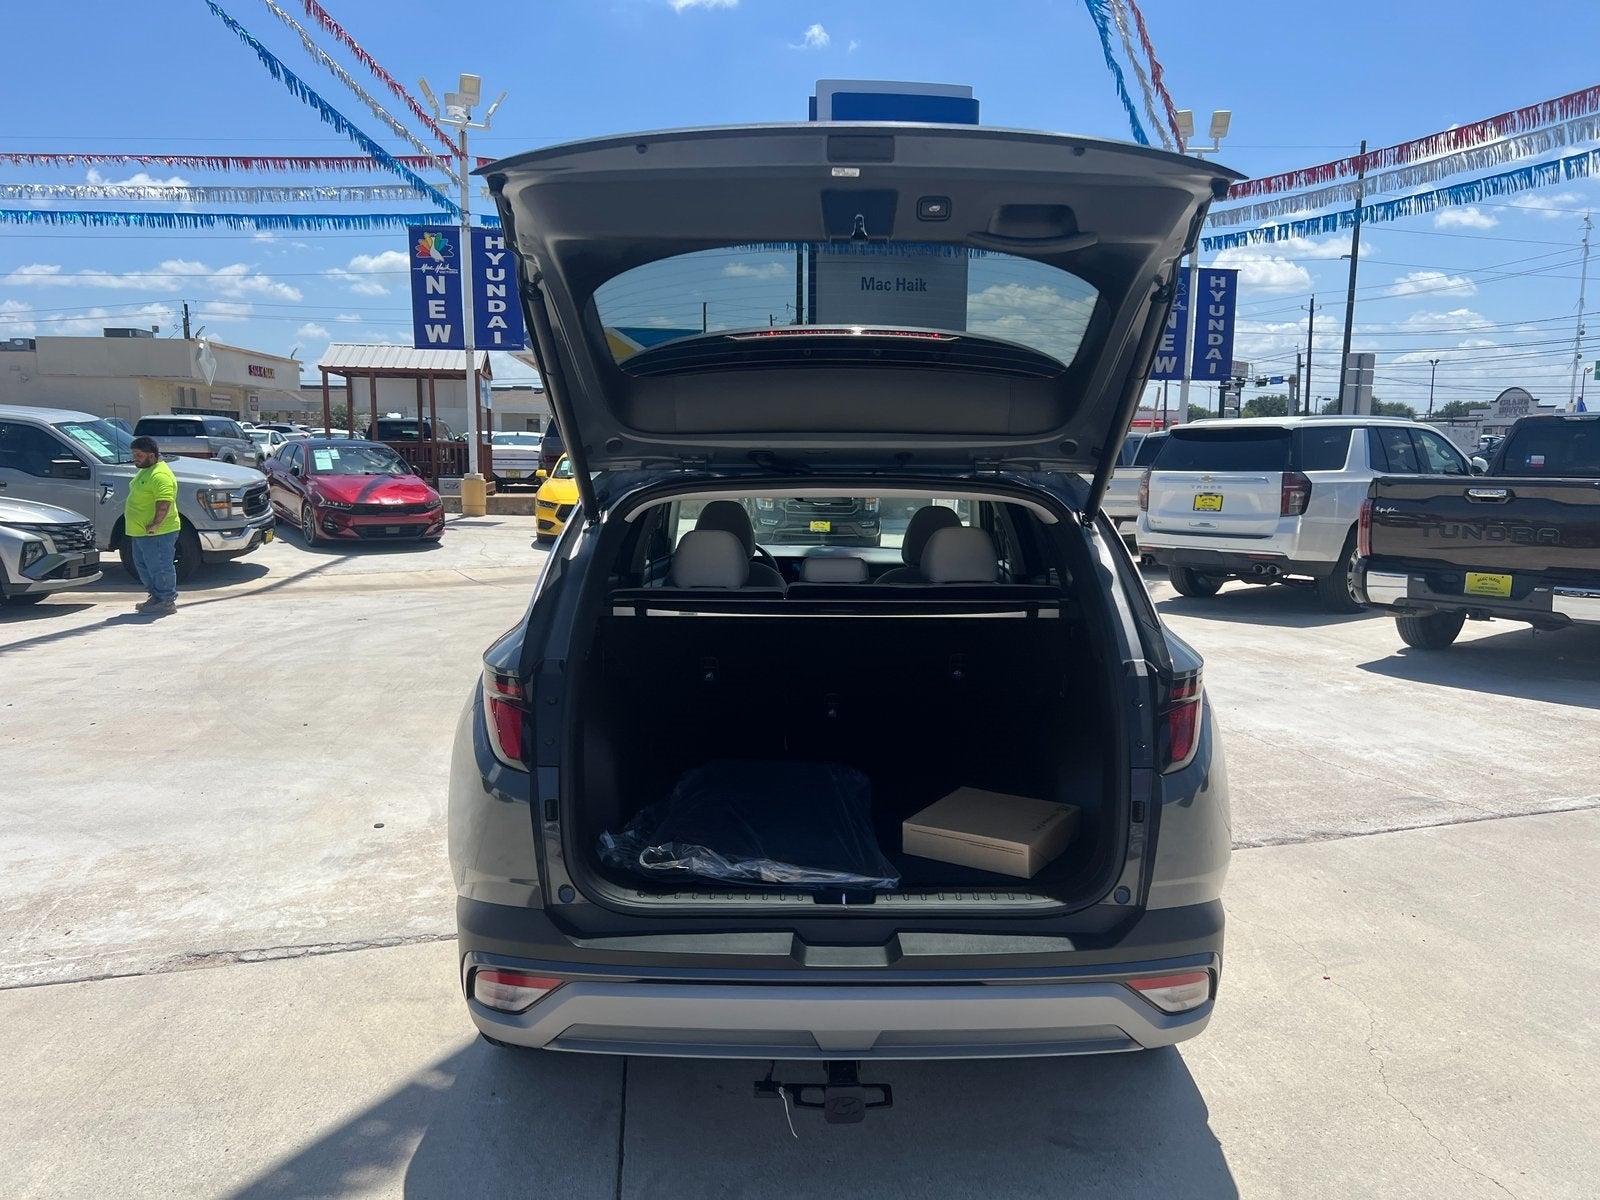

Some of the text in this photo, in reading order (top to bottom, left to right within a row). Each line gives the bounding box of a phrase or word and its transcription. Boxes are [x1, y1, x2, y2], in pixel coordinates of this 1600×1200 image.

[425, 275, 451, 343] NEW
[485, 236, 507, 344] HYUNDAI
[861, 276, 927, 292] Mac Haik
[1205, 276, 1226, 374] HYUNDAI
[1418, 522, 1561, 544] TUNDRA
